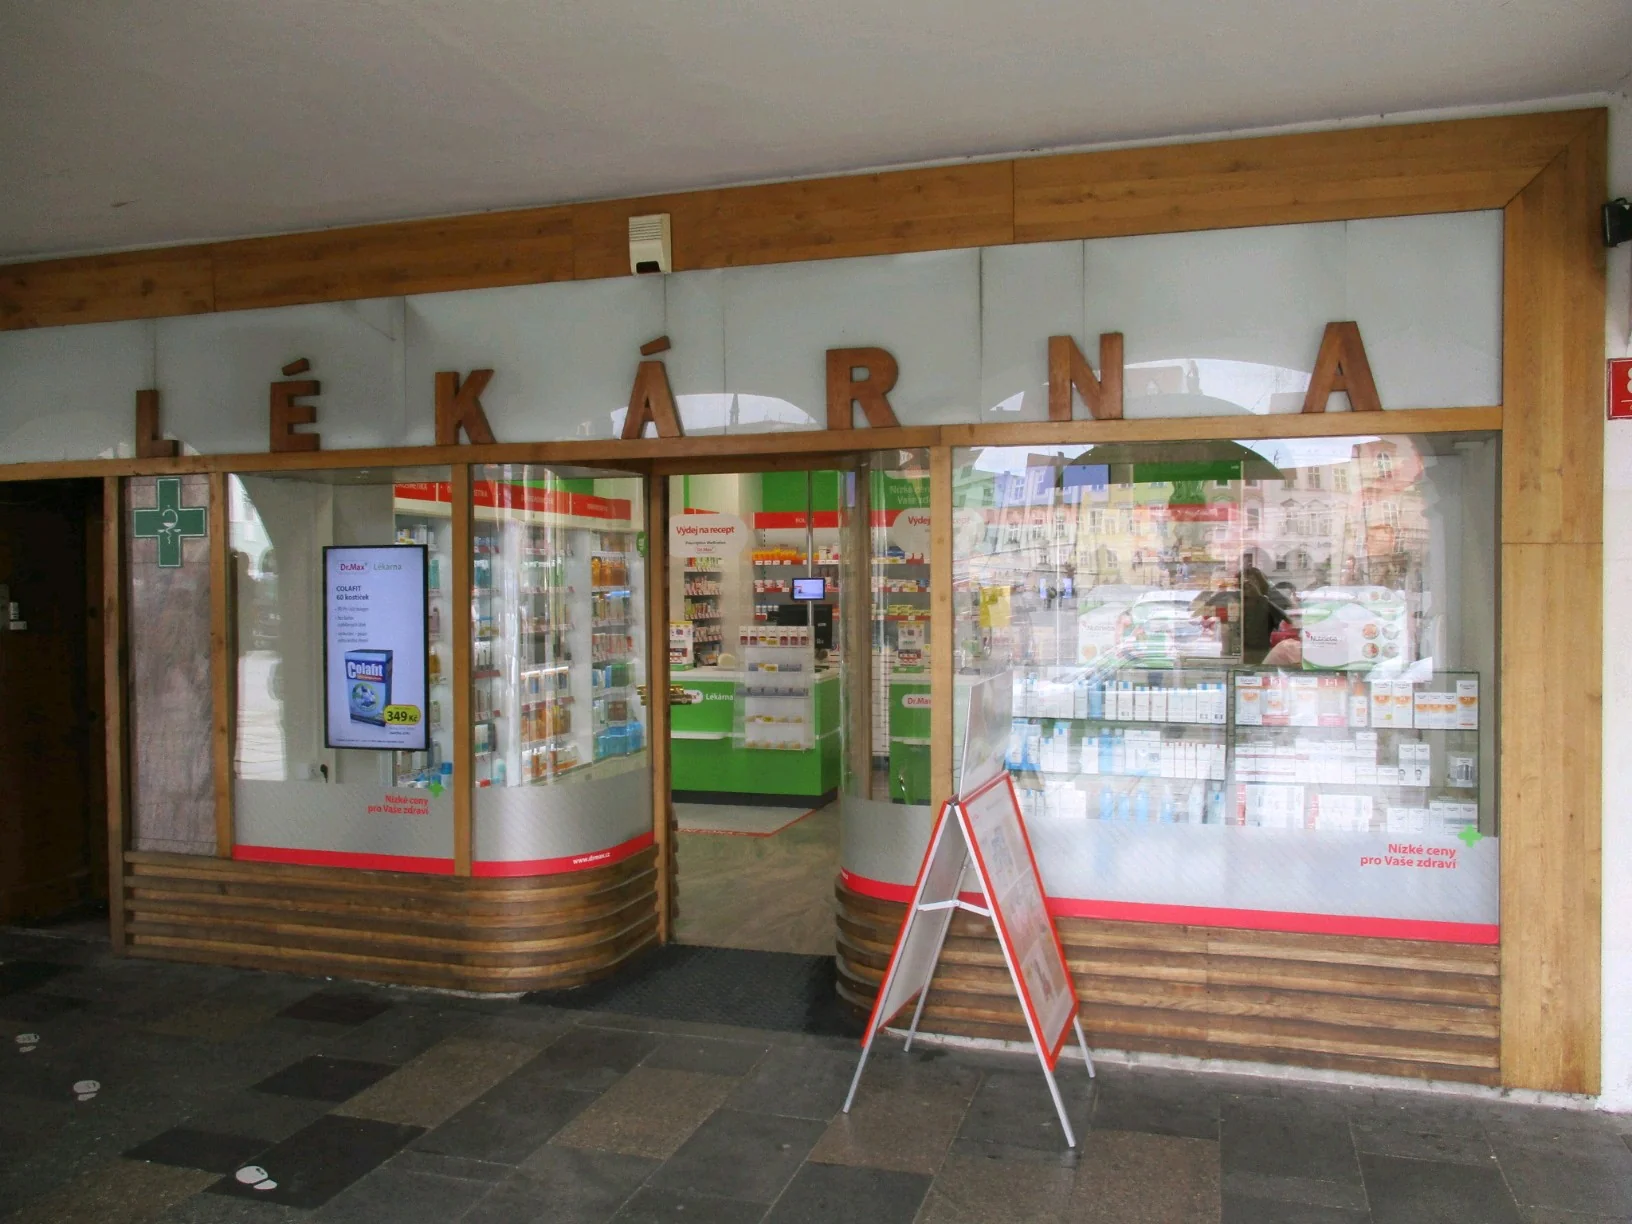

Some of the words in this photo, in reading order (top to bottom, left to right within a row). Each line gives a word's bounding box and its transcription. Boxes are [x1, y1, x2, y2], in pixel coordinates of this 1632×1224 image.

[136, 321, 1382, 457] LÉKÁRNA
[676, 526, 697, 536] Výdej
[710, 526, 735, 535] recept
[340, 563, 365, 571] Dr.Max
[347, 661, 383, 678] Colafit
[705, 693, 734, 701] Lékárna
[387, 711, 408, 721] 349
[409, 714, 418, 723] Kč
[409, 797, 429, 807] ceny
[367, 804, 382, 815] pro
[1388, 843, 1424, 855] Nízké
[1426, 847, 1456, 859] ceny
[1360, 856, 1382, 867] pro
[1384, 855, 1414, 867] Vaše
[1416, 858, 1456, 869] zdraví
